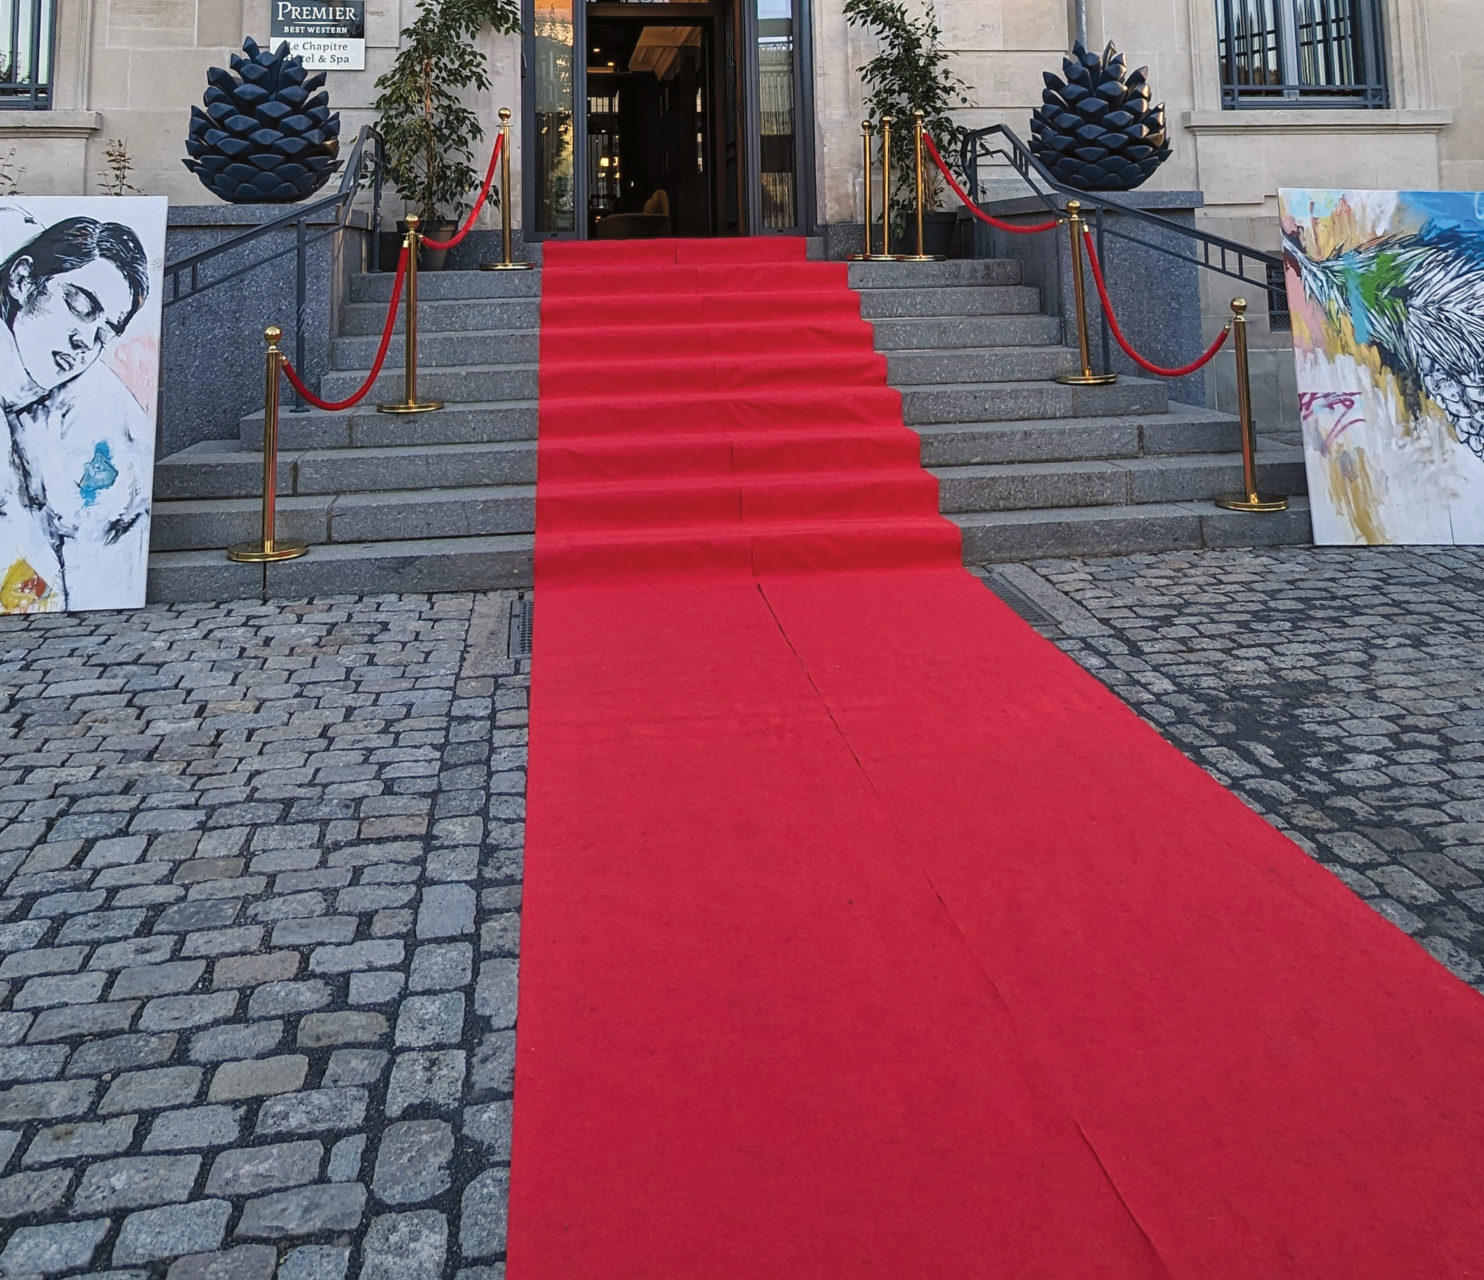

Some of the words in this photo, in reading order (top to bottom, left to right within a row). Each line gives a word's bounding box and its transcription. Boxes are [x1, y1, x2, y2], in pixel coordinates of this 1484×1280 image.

[277, 1, 357, 21] PREMIER
[307, 26, 348, 34] WESTERN
[302, 41, 348, 53] Chapitre
[318, 54, 327, 63] &
[330, 54, 350, 65] Spa
